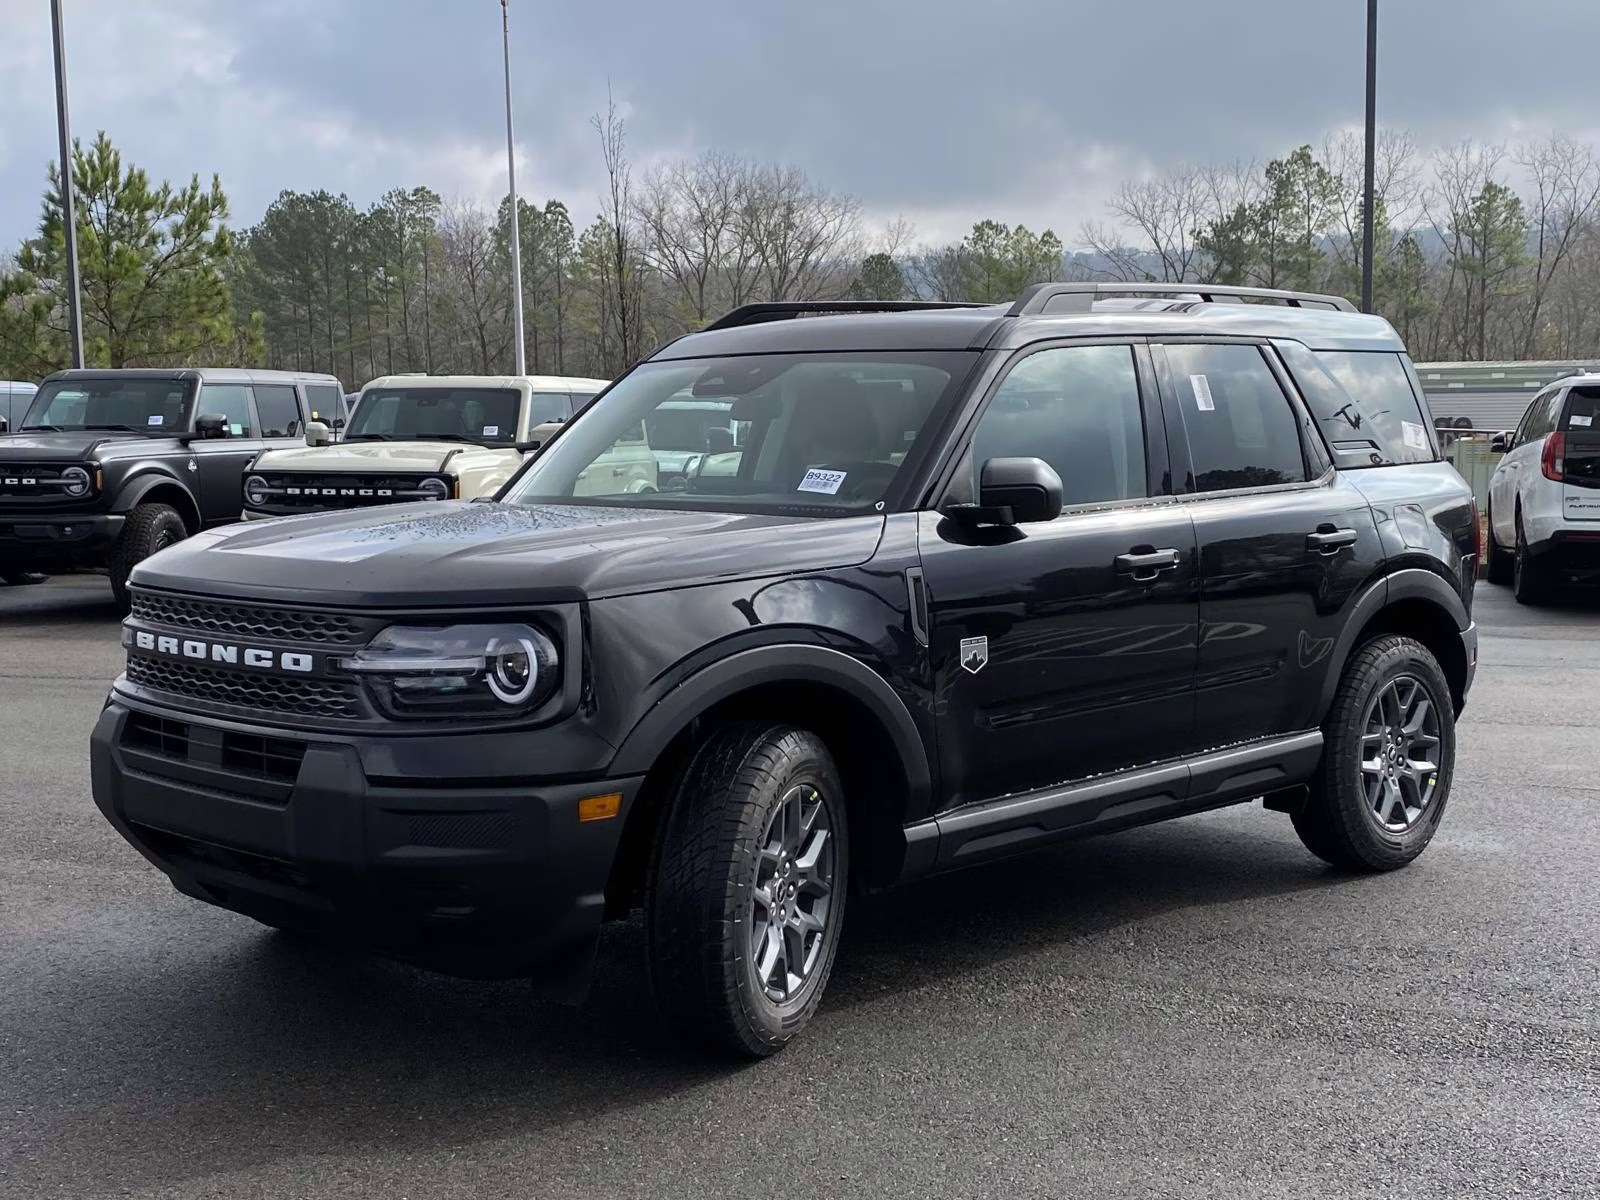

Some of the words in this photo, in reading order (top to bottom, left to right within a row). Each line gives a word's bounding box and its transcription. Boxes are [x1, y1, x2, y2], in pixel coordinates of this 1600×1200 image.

[0, 477, 36, 485] CO
[806, 471, 842, 483] B9322
[287, 487, 392, 496] BRONCO
[136, 631, 312, 673] BRONCO
